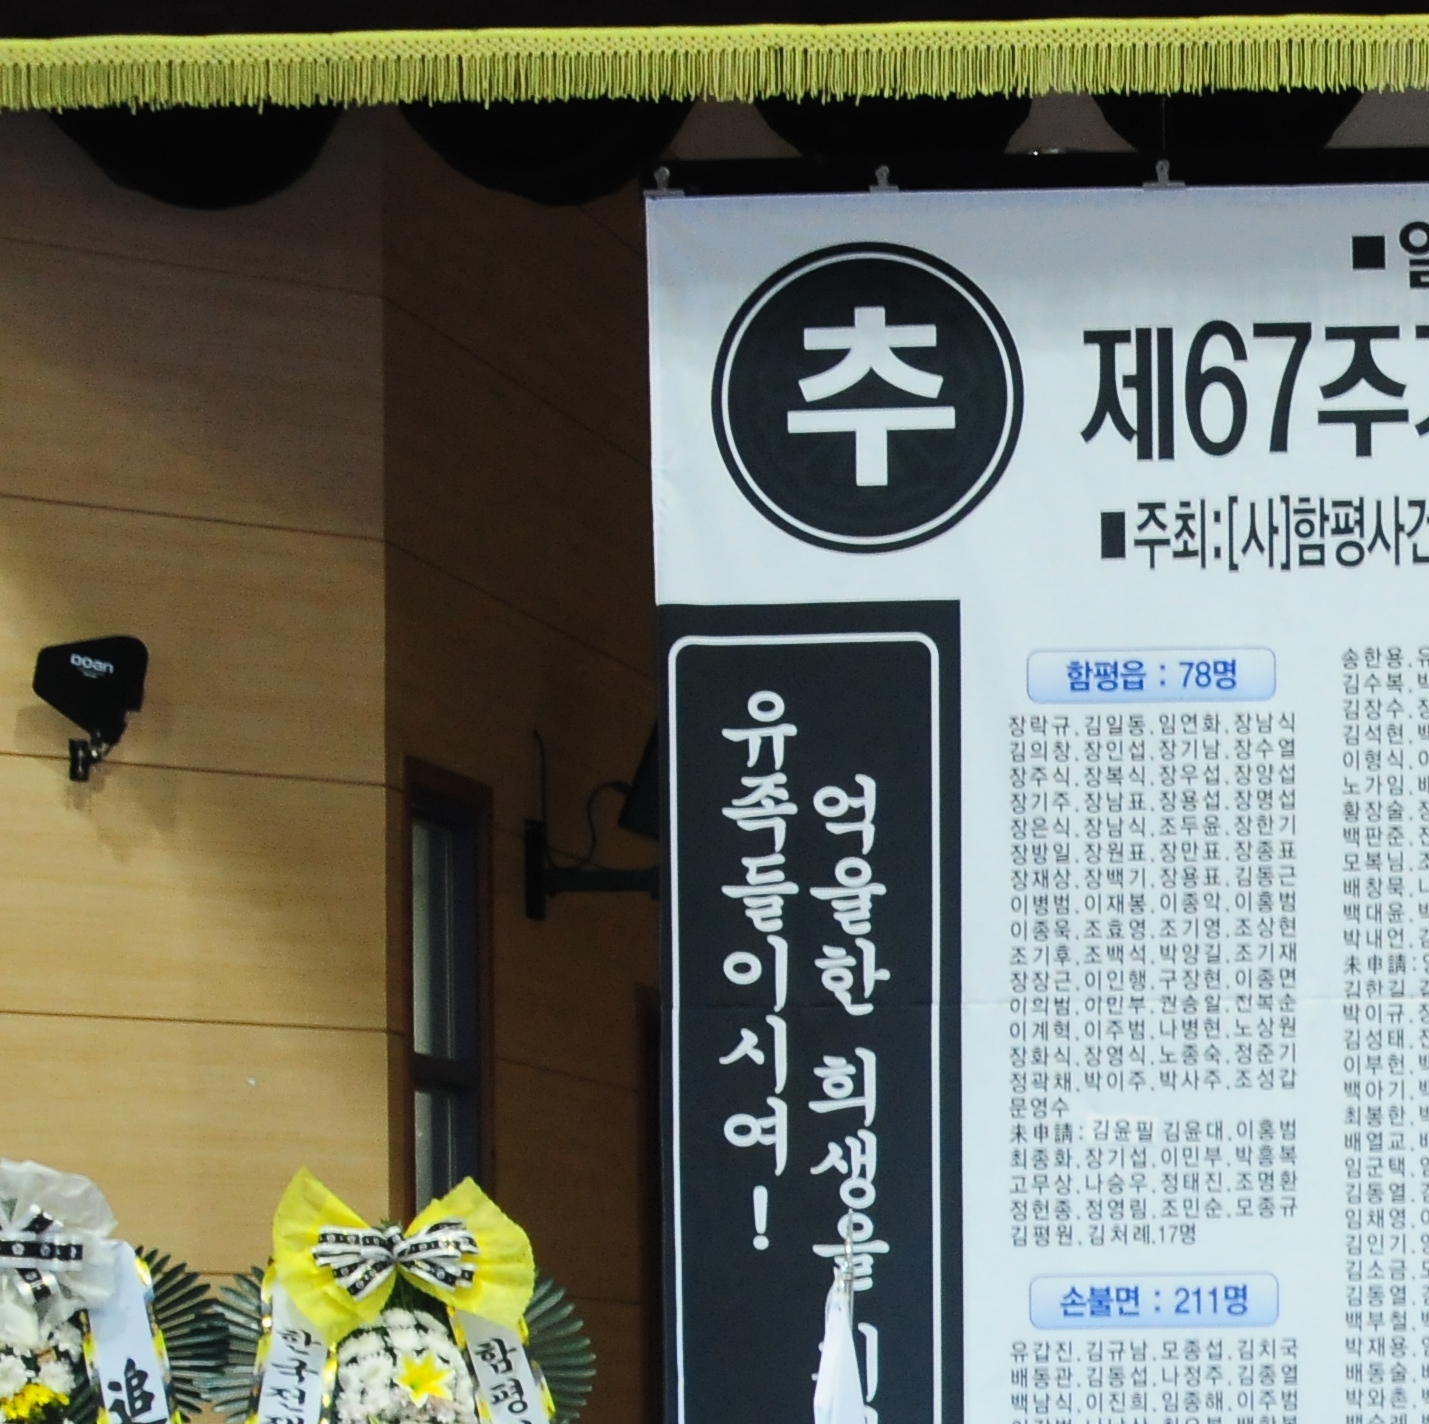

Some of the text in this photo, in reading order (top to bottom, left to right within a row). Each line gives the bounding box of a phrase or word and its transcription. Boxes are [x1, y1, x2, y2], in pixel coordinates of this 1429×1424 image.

[787, 306, 956, 487] 추
[1067, 660, 1146, 692] 함평읍
[1179, 659, 1237, 690] 78명
[810, 774, 890, 1016] 억울한
[1060, 1286, 1140, 1317] 손불면
[1174, 1284, 1248, 1316] 211명
